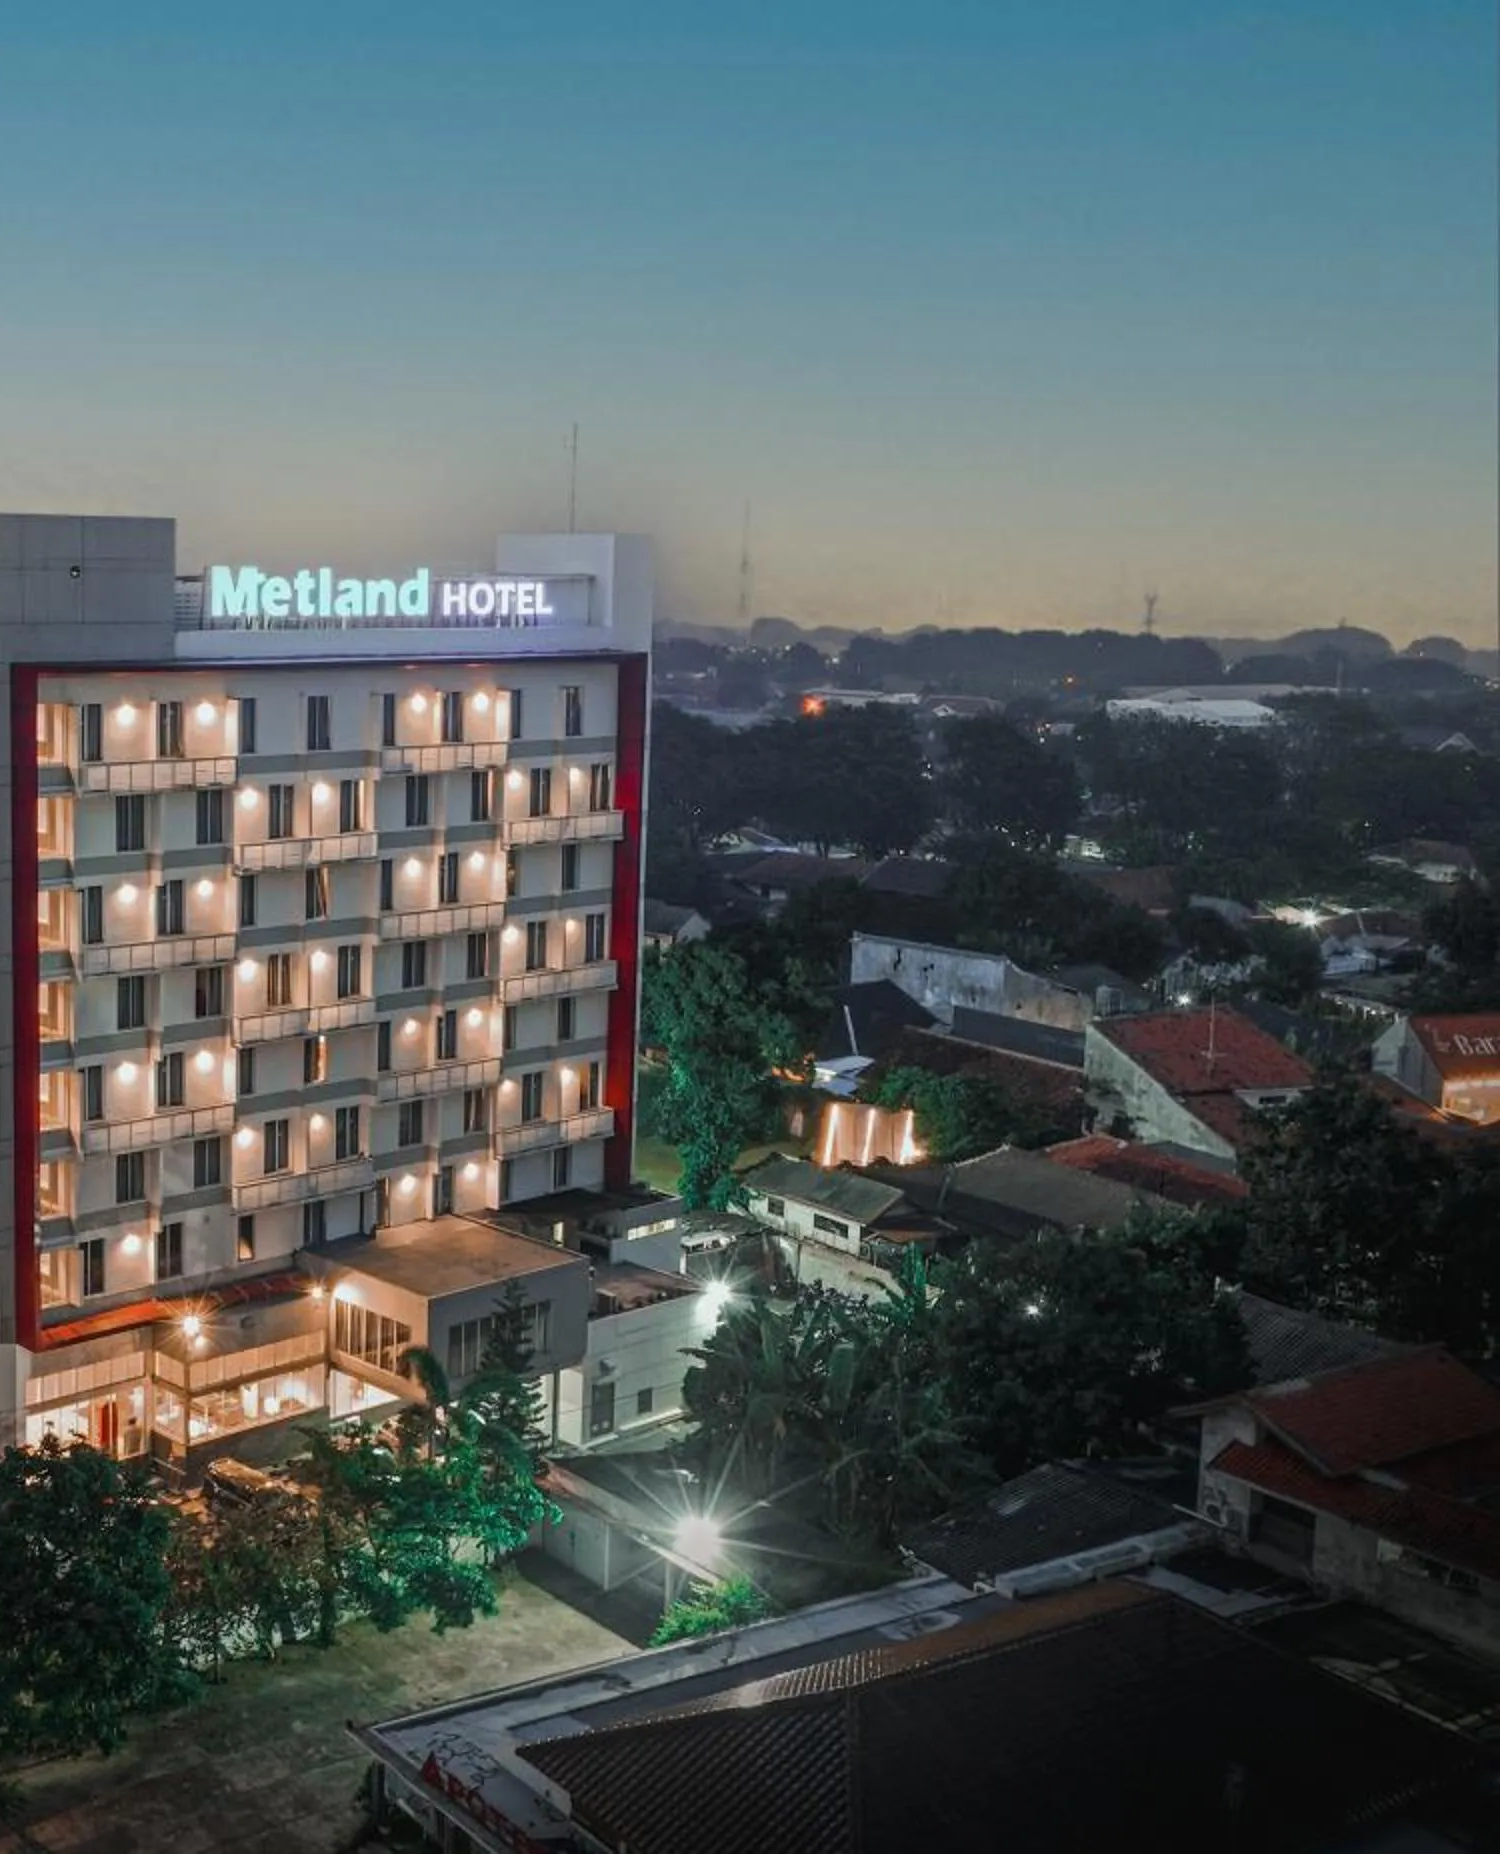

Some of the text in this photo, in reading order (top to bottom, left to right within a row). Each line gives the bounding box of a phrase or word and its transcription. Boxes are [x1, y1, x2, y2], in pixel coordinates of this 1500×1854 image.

[210, 565, 553, 617] Metland HOTEL
[1453, 1033, 1500, 1056] Bar
